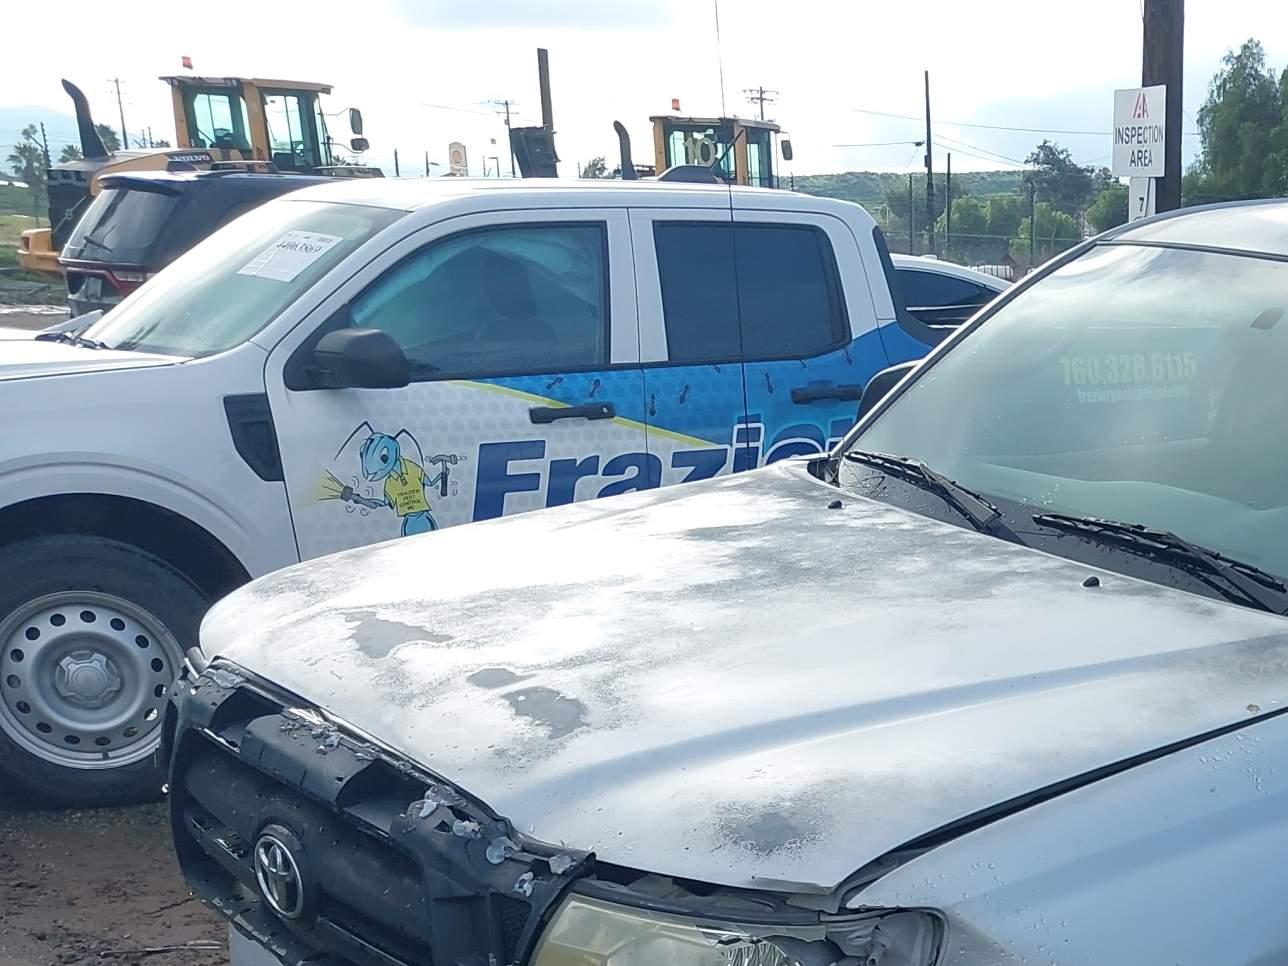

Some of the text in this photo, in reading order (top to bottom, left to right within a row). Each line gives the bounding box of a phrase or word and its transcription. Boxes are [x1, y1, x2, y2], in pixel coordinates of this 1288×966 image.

[1114, 125, 1164, 145] INSPECTION
[174, 154, 211, 162] VOLVO
[1129, 149, 1153, 168] AREA
[1138, 197, 1145, 212] 7
